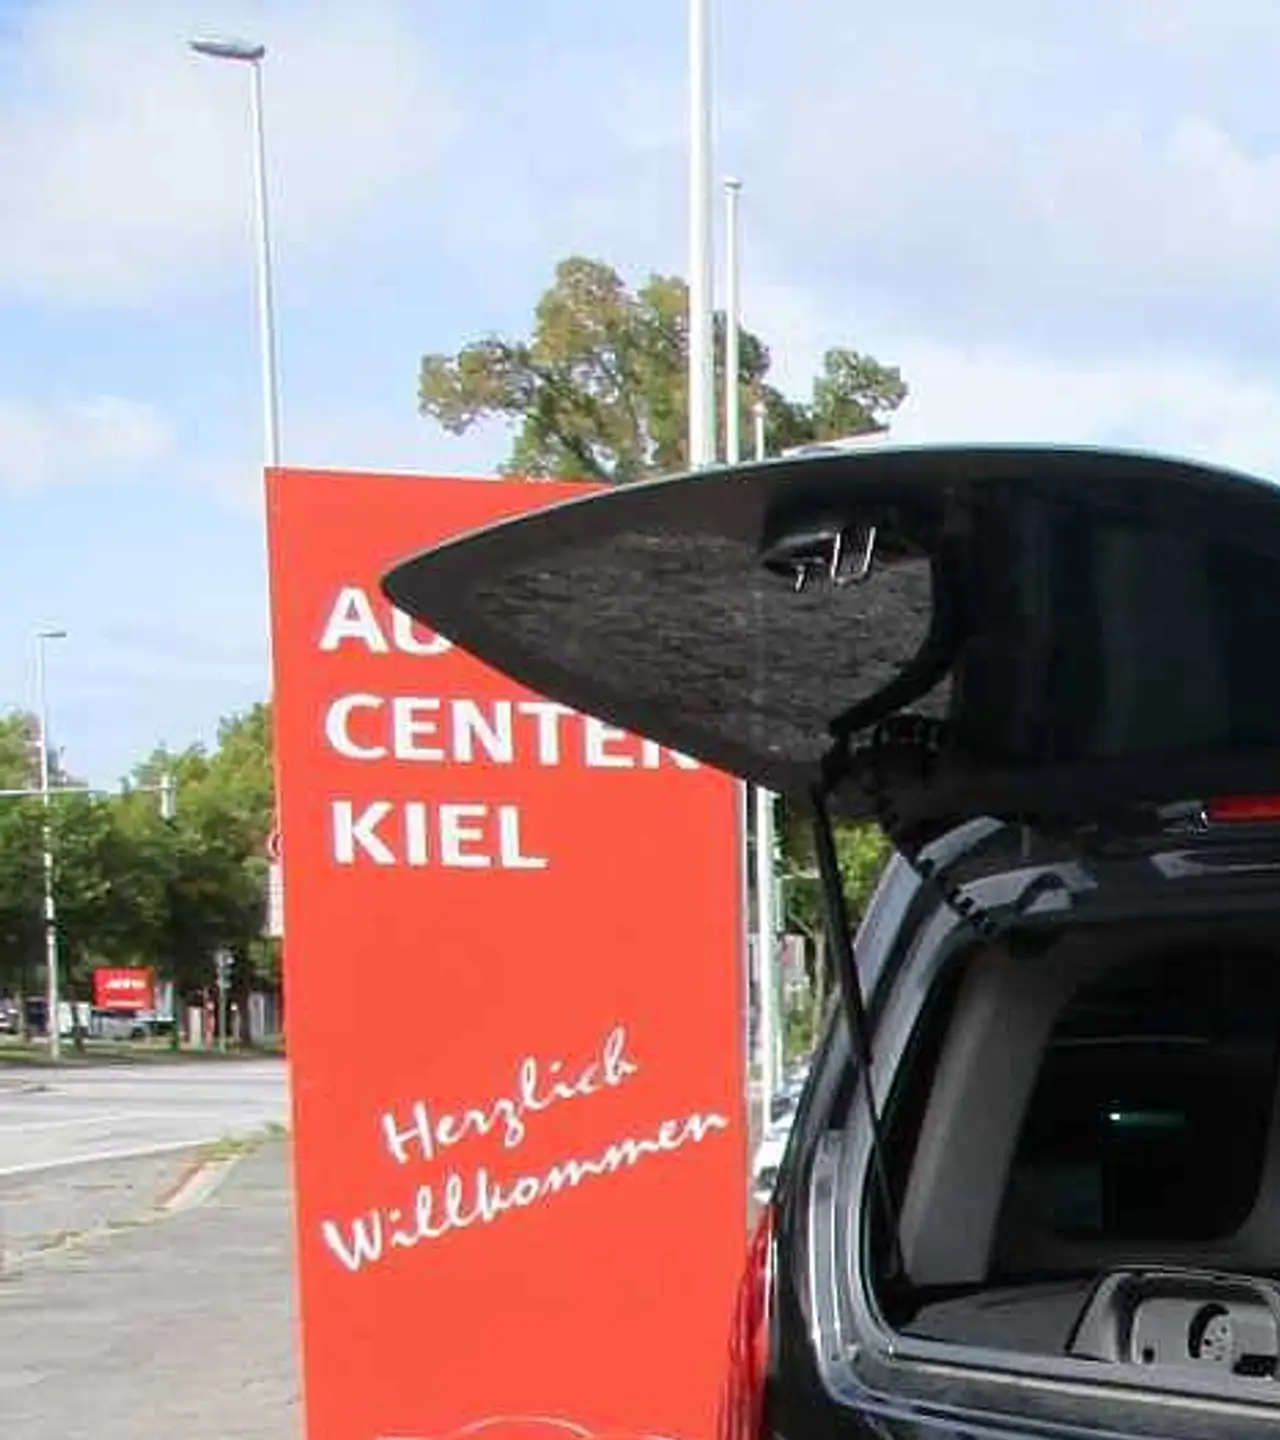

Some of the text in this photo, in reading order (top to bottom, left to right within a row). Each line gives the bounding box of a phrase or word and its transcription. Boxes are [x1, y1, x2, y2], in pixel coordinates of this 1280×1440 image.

[331, 799, 549, 870] KIEL
[382, 1024, 638, 1162] Herzlich
[321, 1113, 728, 1272] Willkommen
